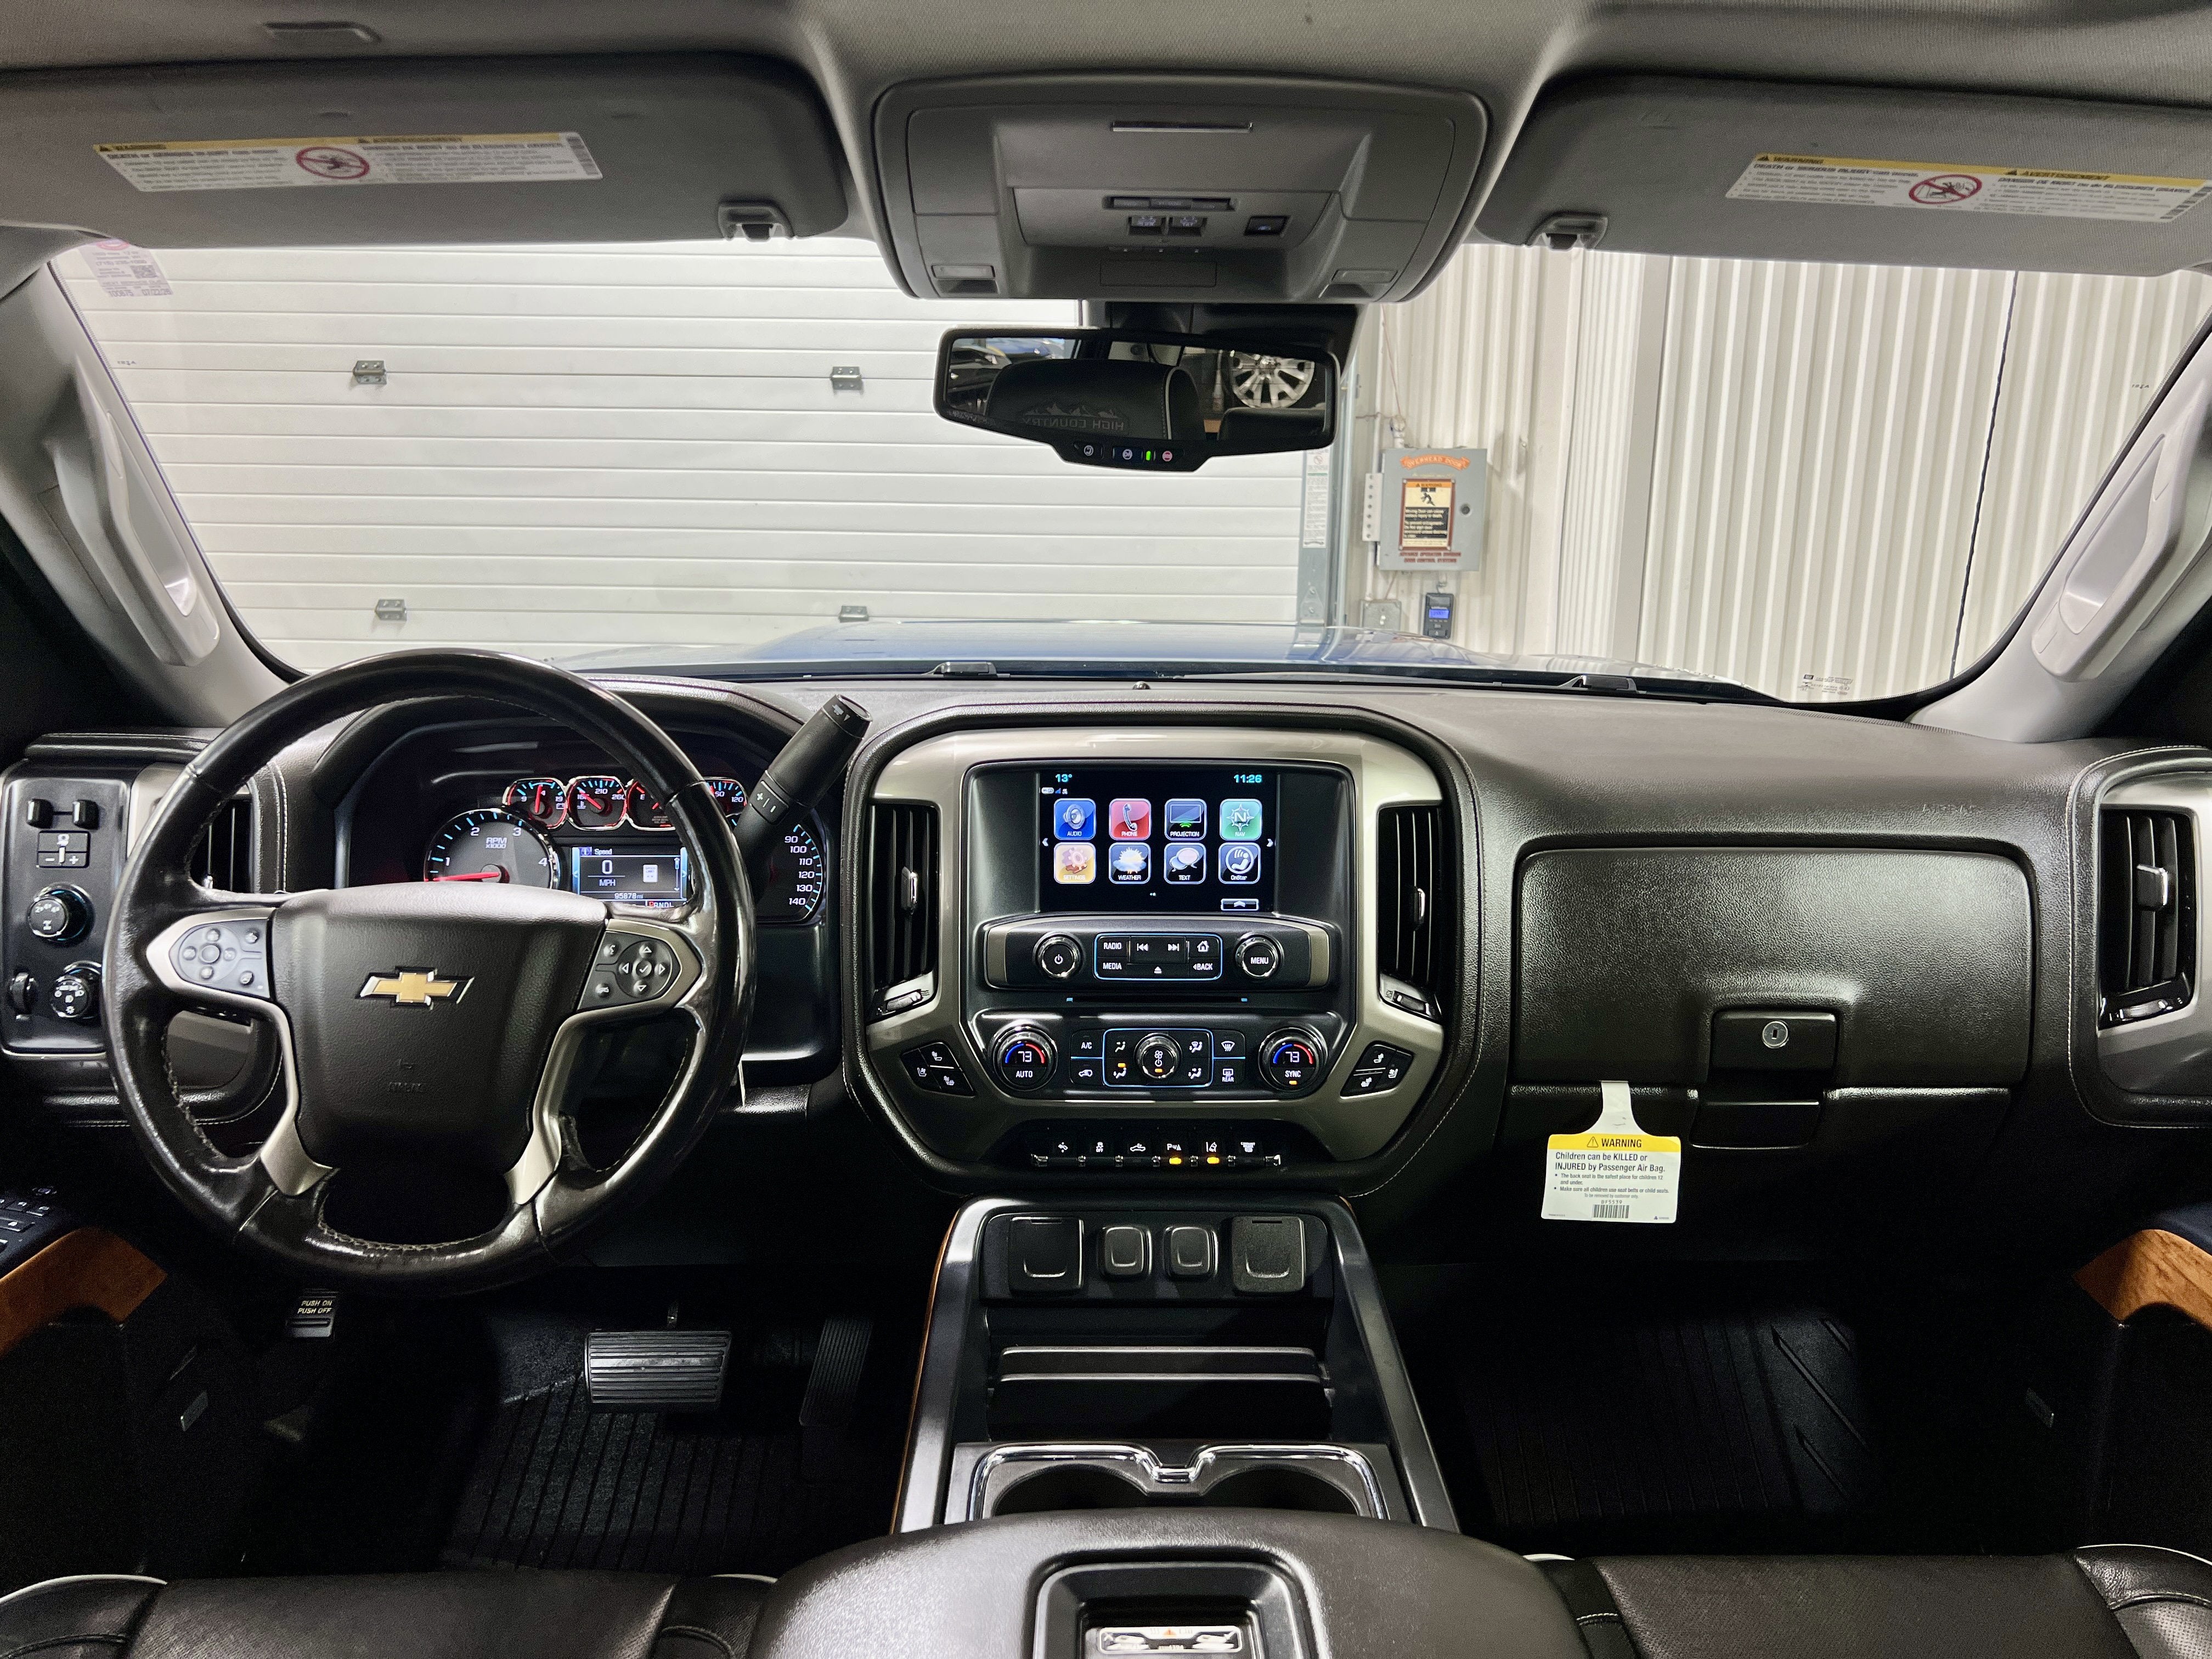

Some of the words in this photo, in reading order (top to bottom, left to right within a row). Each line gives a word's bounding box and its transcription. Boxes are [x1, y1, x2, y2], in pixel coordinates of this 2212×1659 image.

[1234, 774, 1262, 783] 11:26
[470, 827, 480, 836] 2
[512, 827, 522, 837] 3
[445, 857, 450, 866] 1
[538, 857, 548, 867] 4
[601, 859, 613, 874] 0
[1103, 942, 1122, 950] RADIO
[1250, 957, 1269, 965] MENU
[1103, 962, 1122, 970] MEDIA
[1197, 962, 1213, 971] BACK
[1018, 1051, 1032, 1063] 73
[1285, 1051, 1300, 1063] 73
[1601, 1138, 1642, 1148] WARNING
[1555, 1152, 1585, 1160] Children
[1602, 1153, 1611, 1161] be
[1588, 1164, 1596, 1172] by
[1599, 1164, 1635, 1173] Passenger
[1650, 1164, 1666, 1173] Bag.
